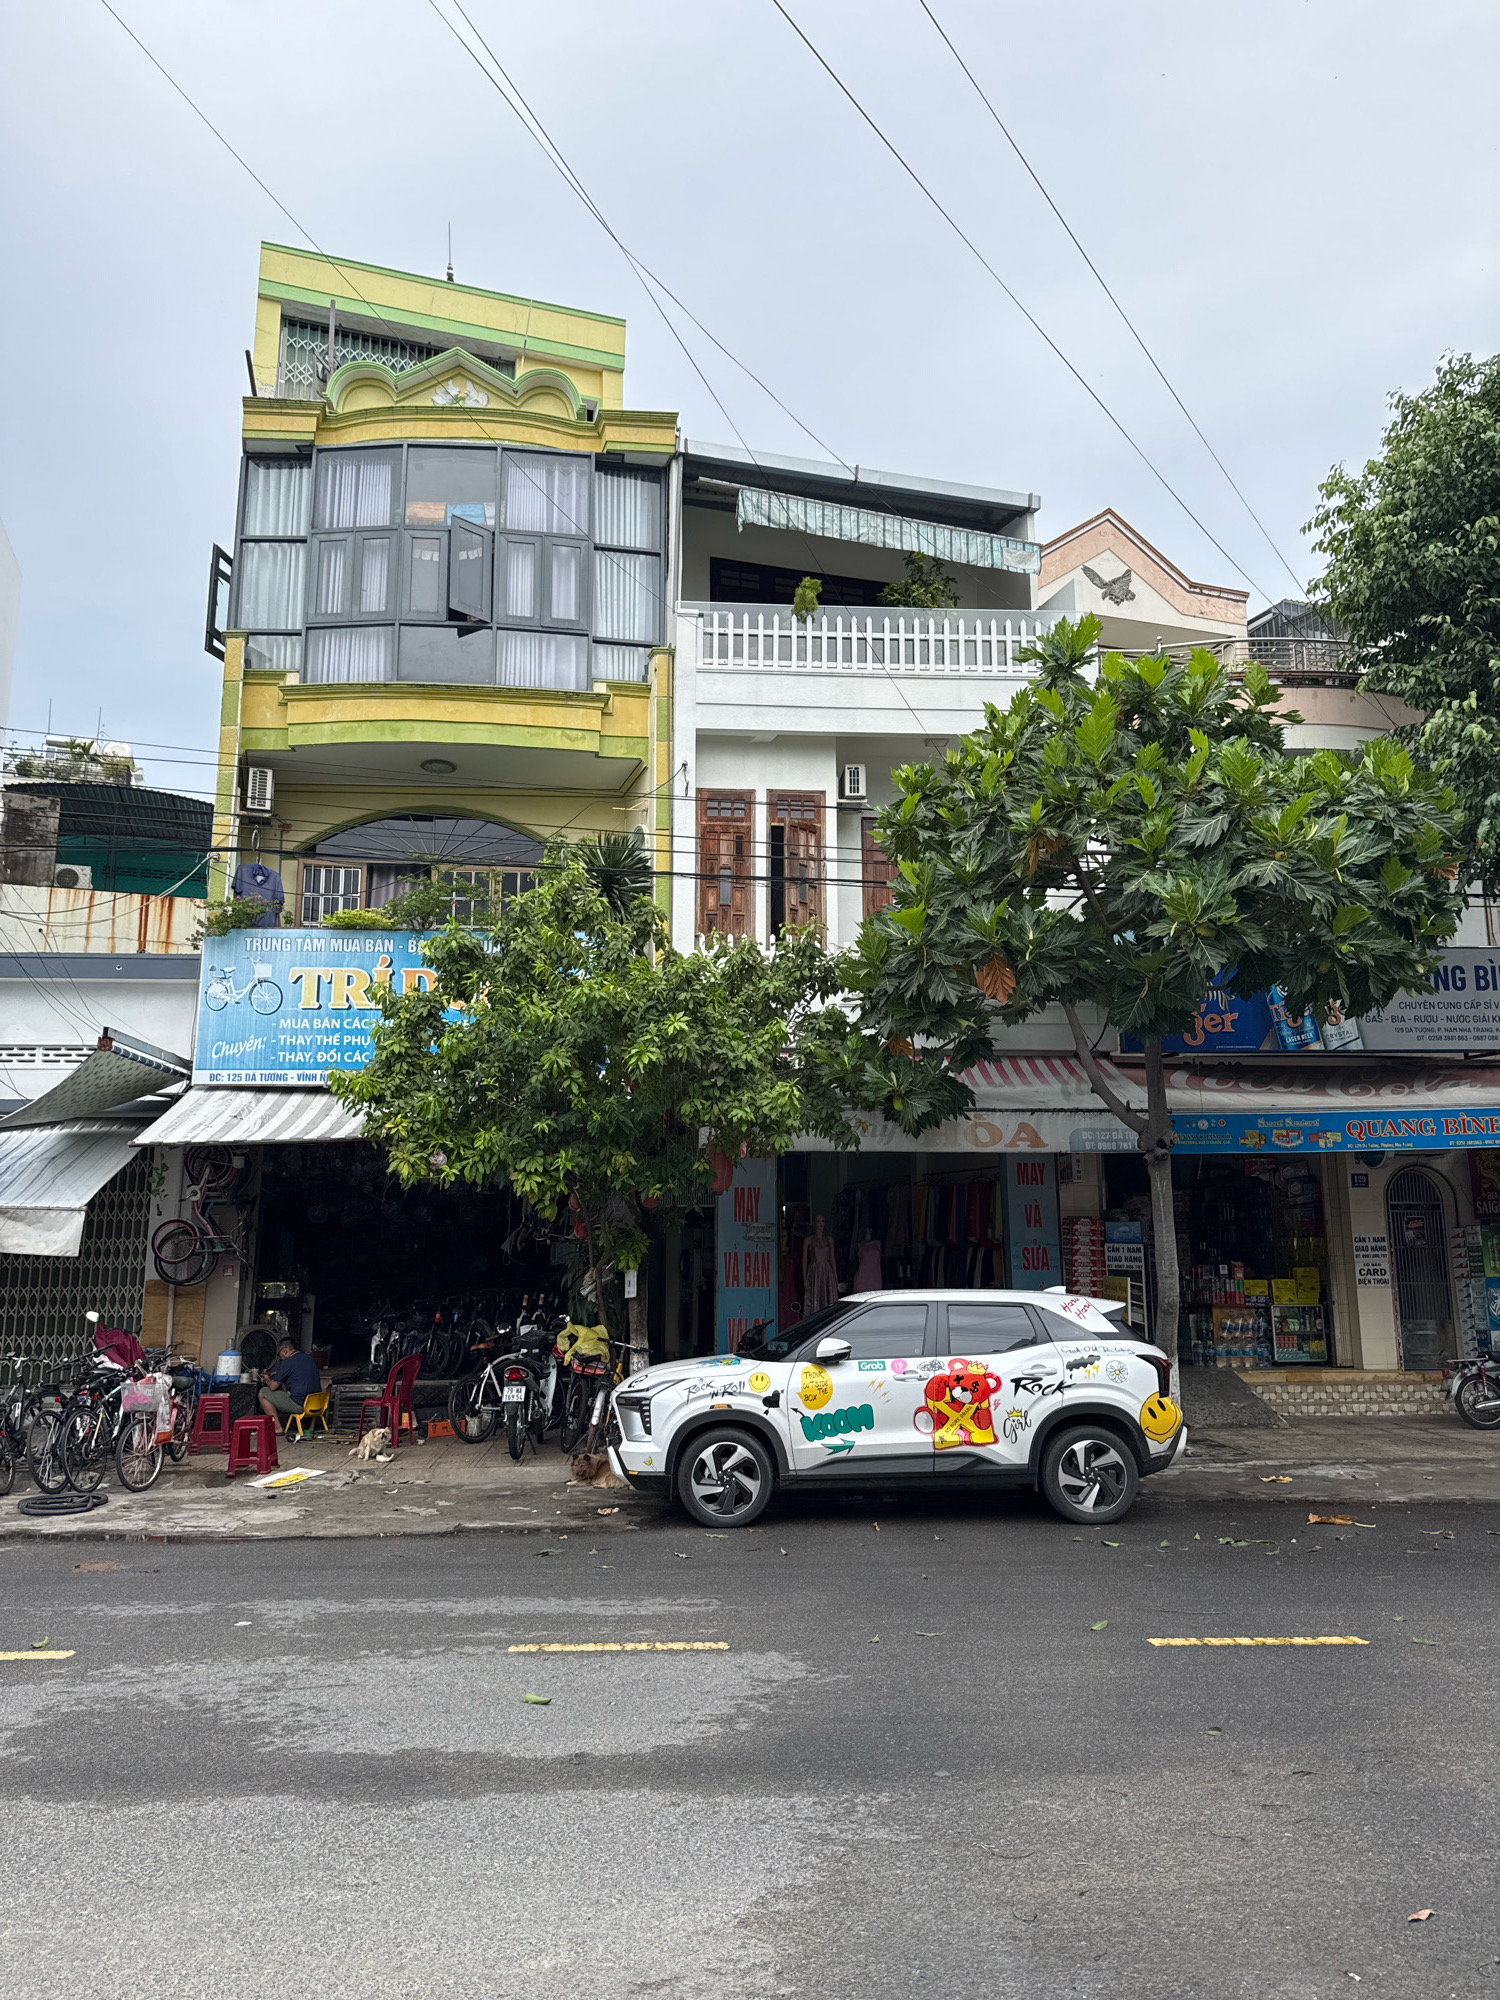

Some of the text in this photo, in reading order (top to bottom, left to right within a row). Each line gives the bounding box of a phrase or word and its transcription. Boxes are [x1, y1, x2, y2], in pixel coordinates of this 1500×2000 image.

[244, 937, 291, 952] TRUNG
[296, 935, 325, 952] TÂM
[330, 938, 361, 952] MUA
[365, 936, 394, 953] BÁN
[289, 954, 395, 1010] TRÍ
[1434, 959, 1500, 992] NG BÌ
[1399, 999, 1435, 1009] CHUYÊN
[1437, 1001, 1462, 1010] CUNG
[1464, 998, 1482, 1009] CẤP
[279, 1018, 310, 1029] MUA
[313, 1016, 341, 1029] BÁN
[343, 1016, 369, 1029] CÁC
[1365, 1015, 1383, 1023] GAS
[1391, 1015, 1406, 1023] BIA
[1414, 1014, 1438, 1025] RƯỢU
[1446, 1013, 1471, 1023] NƯỚC
[211, 1034, 267, 1059] Chuyên:
[278, 1032, 371, 1048] THAY THẾ PHỤ
[277, 1048, 370, 1064] THAY, ĐỔI CÁC
[209, 1073, 224, 1082] ĐC:
[227, 1073, 242, 1082] 125
[260, 1072, 288, 1084] TƯỢNG
[1096, 1131, 1110, 1140] 127
[1346, 1118, 1436, 1141] QUANG
[1016, 1162, 1046, 1186] MAY
[1354, 1175, 1367, 1183] 129
[734, 1187, 761, 1222] MAY
[1476, 1200, 1500, 1214] SAIG
[1024, 1199, 1043, 1228] VÀ
[1022, 1238, 1050, 1271] SỬA
[1370, 1244, 1387, 1252] HÀNG
[1124, 1254, 1143, 1263] HÀNG
[724, 1244, 770, 1288] VÀ BÁN
[1358, 1268, 1387, 1277] CARD
[860, 1362, 884, 1370] Grab
[803, 1370, 824, 1380] THINK
[803, 1380, 829, 1390] OUTSIDE
[817, 1387, 829, 1396] THE
[803, 1393, 818, 1402] BOX
[800, 1403, 875, 1443] KOOM
